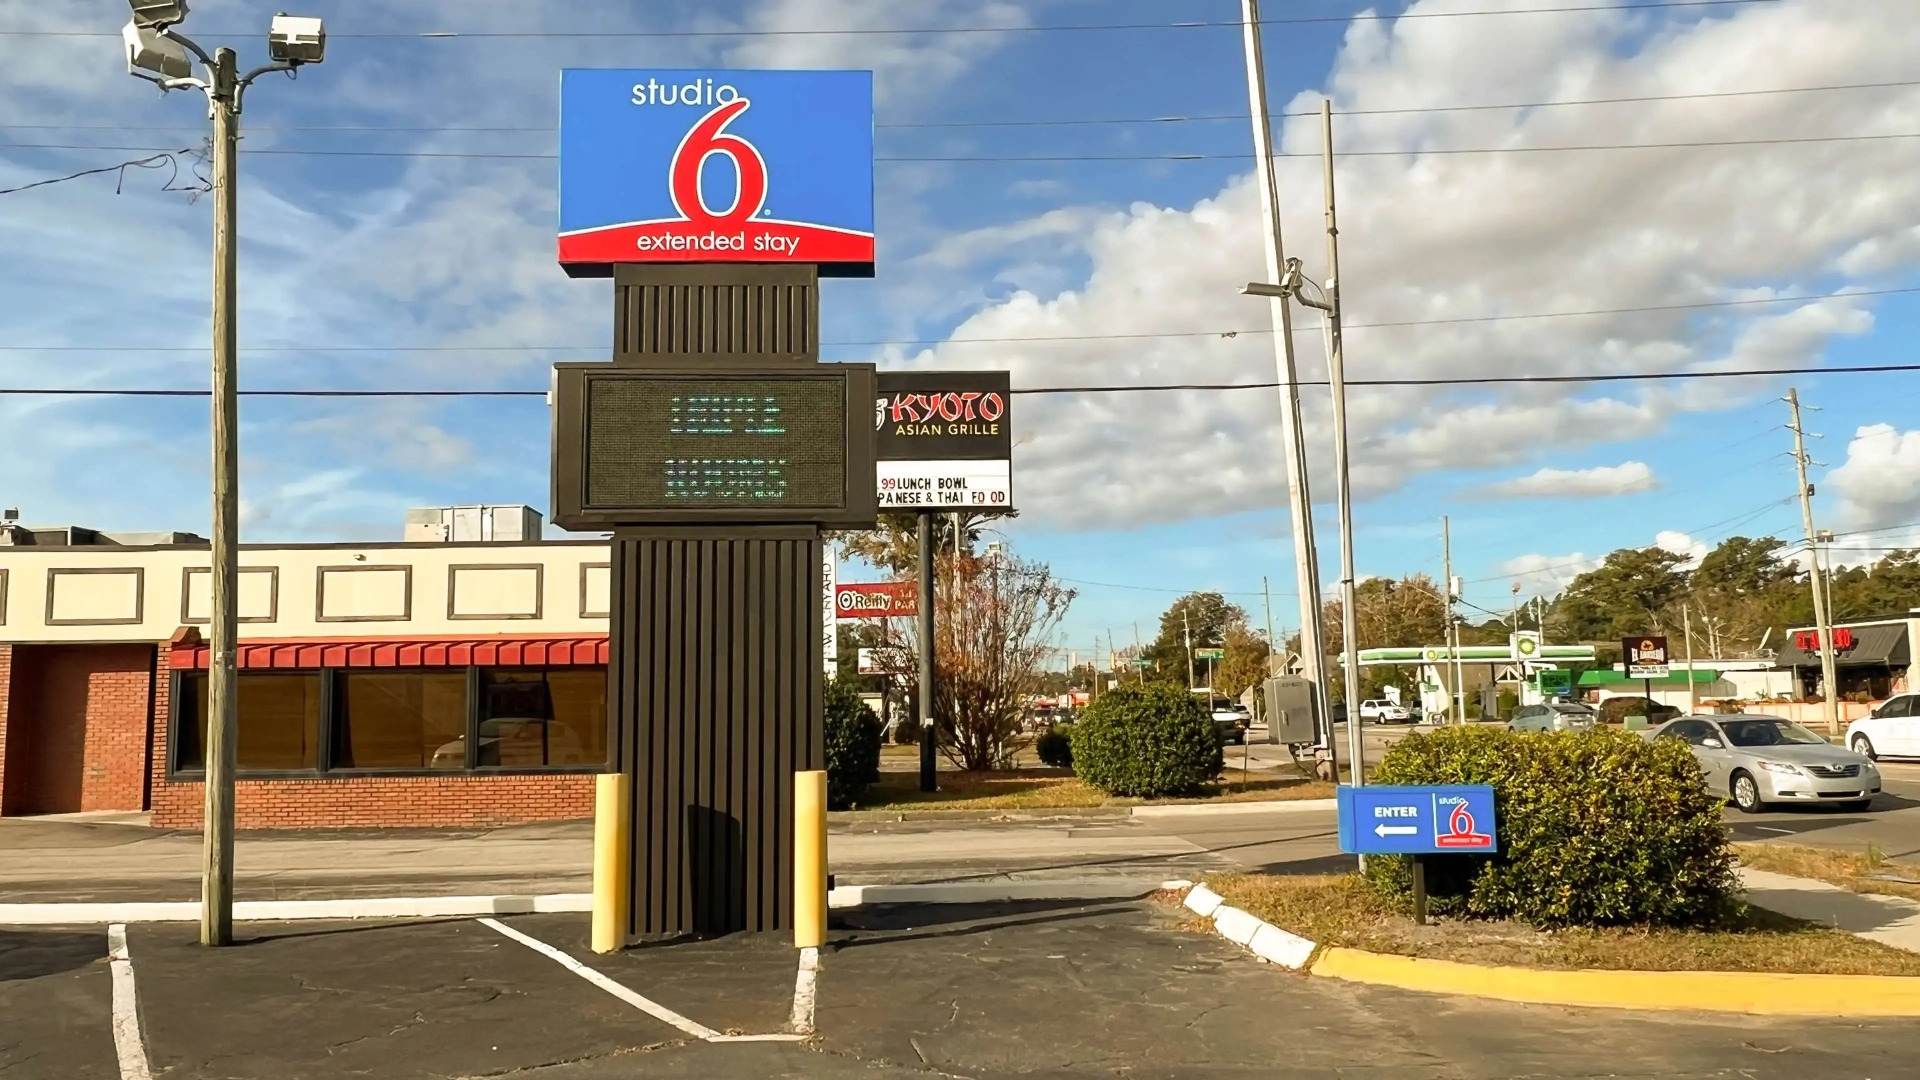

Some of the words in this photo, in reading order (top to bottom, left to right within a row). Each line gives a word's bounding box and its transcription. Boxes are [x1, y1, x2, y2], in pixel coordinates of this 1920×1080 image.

[632, 78, 738, 105] studio
[669, 97, 768, 222] 6
[637, 232, 744, 251] extended
[753, 233, 800, 256] stay
[888, 392, 1004, 423] KYOTO
[896, 424, 942, 436] ASIAN
[948, 424, 999, 435] GRILLE
[897, 478, 931, 490] LUNCH
[938, 477, 968, 489] BOWL
[925, 492, 934, 503] &
[937, 491, 964, 504] THAI
[1374, 806, 1418, 818] ENTER
[1449, 801, 1475, 835] 6
